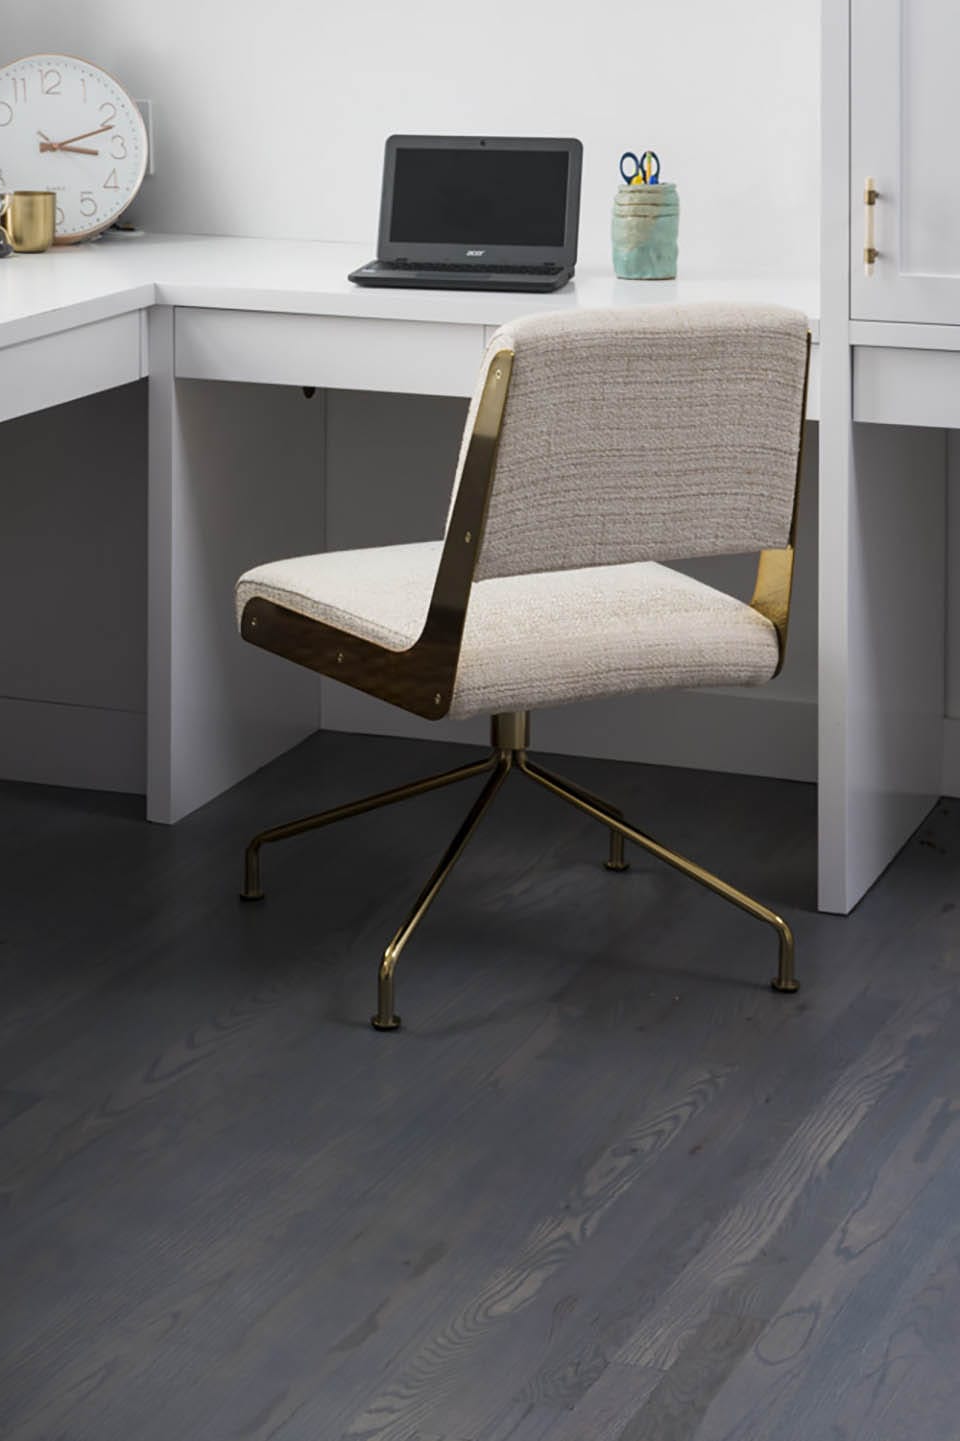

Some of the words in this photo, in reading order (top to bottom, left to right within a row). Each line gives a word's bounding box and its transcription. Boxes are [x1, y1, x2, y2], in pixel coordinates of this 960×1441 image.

[11, 77, 27, 103] 11
[38, 69, 62, 95] 12
[80, 78, 88, 103] 1
[99, 102, 117, 127] 2
[110, 135, 127, 160] 3
[102, 167, 120, 189] 4
[80, 191, 98, 217] 5
